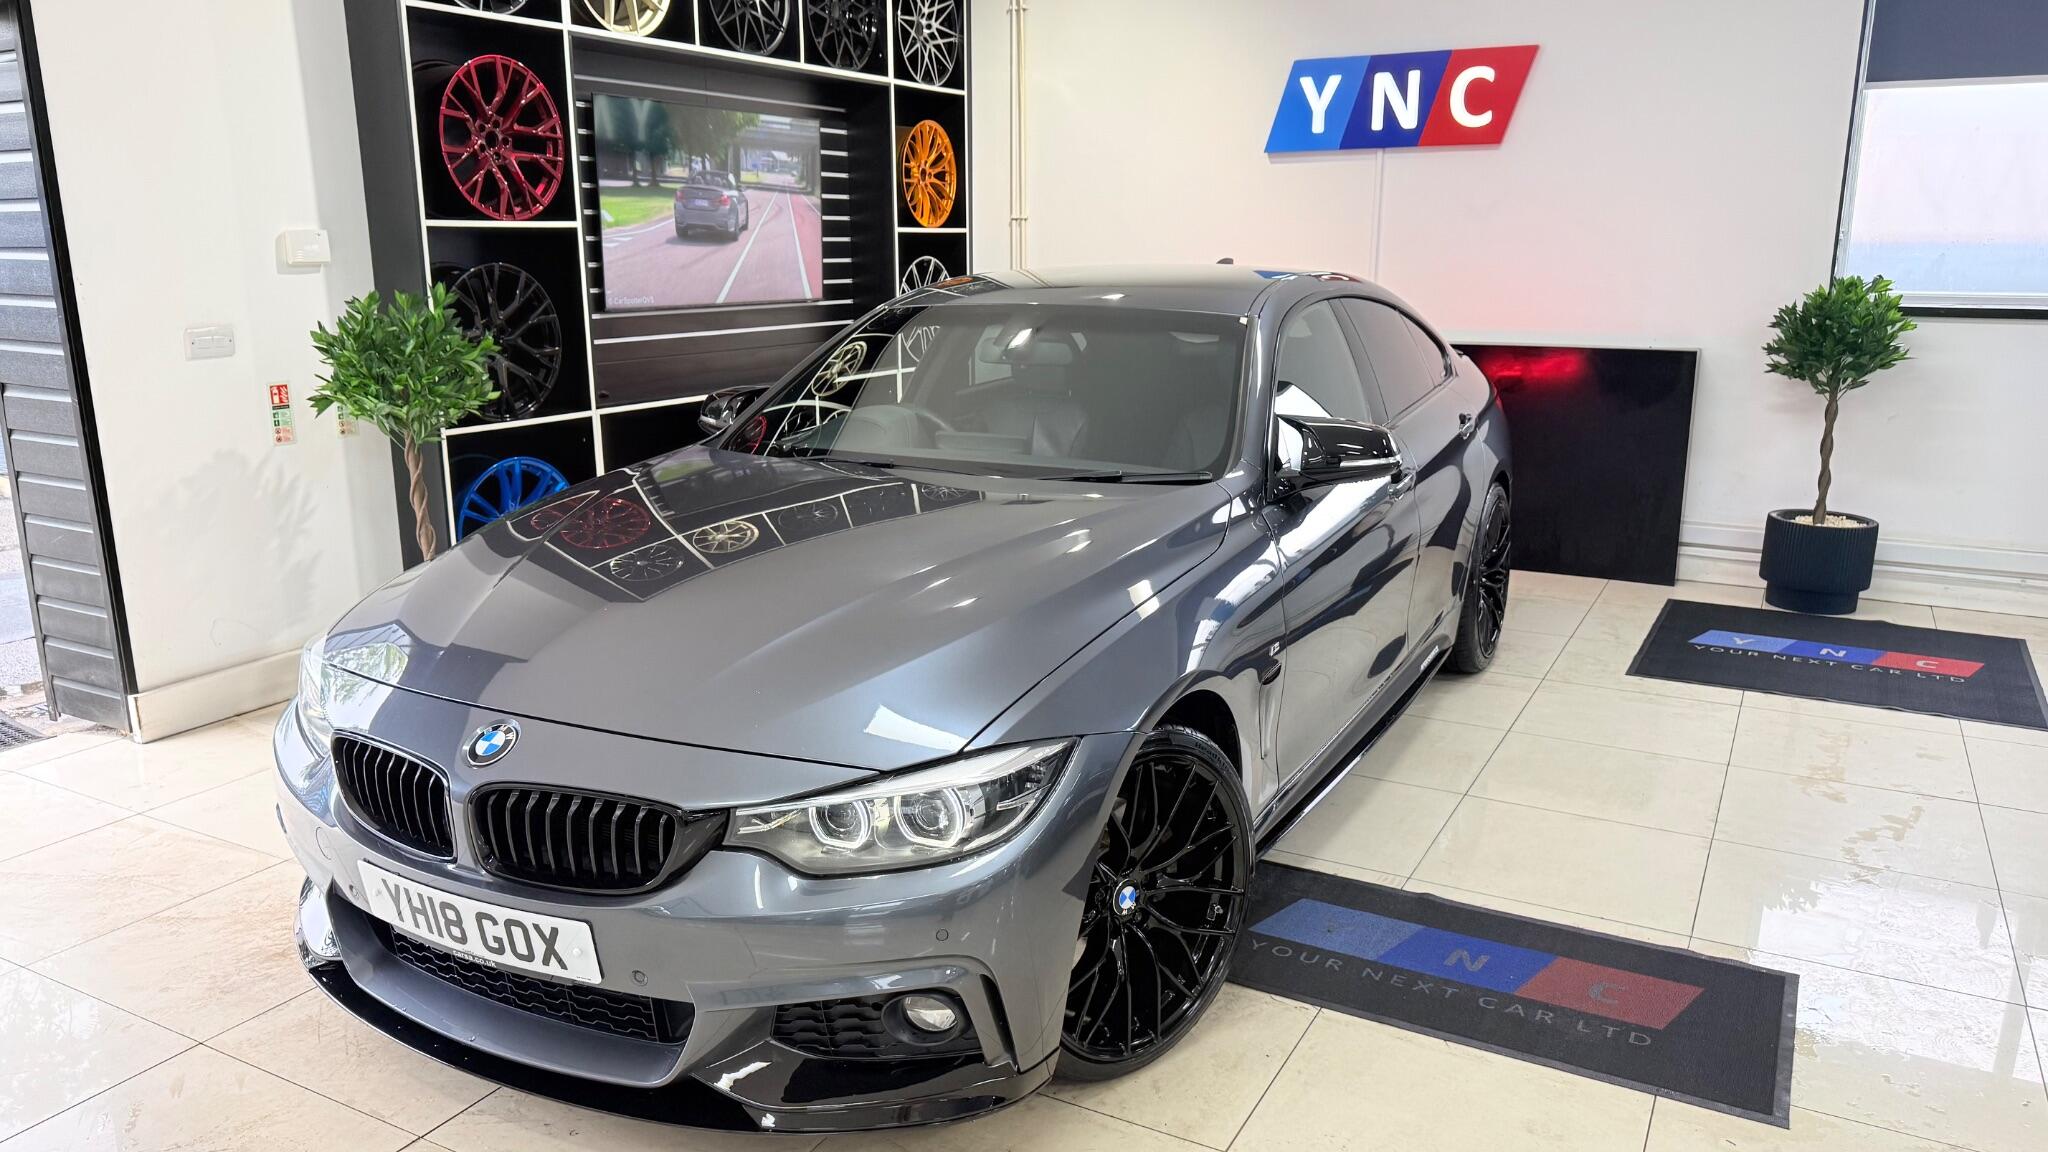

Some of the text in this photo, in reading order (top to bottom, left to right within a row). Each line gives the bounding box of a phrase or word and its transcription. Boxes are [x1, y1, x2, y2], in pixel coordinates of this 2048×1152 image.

[1300, 65, 1496, 134] YNC
[1694, 645, 1966, 683] YOUR NEXT CAR LTD
[381, 878, 569, 972] YH18 GOX
[1251, 938, 1652, 1047] YOUR NEXT CAR LTD
